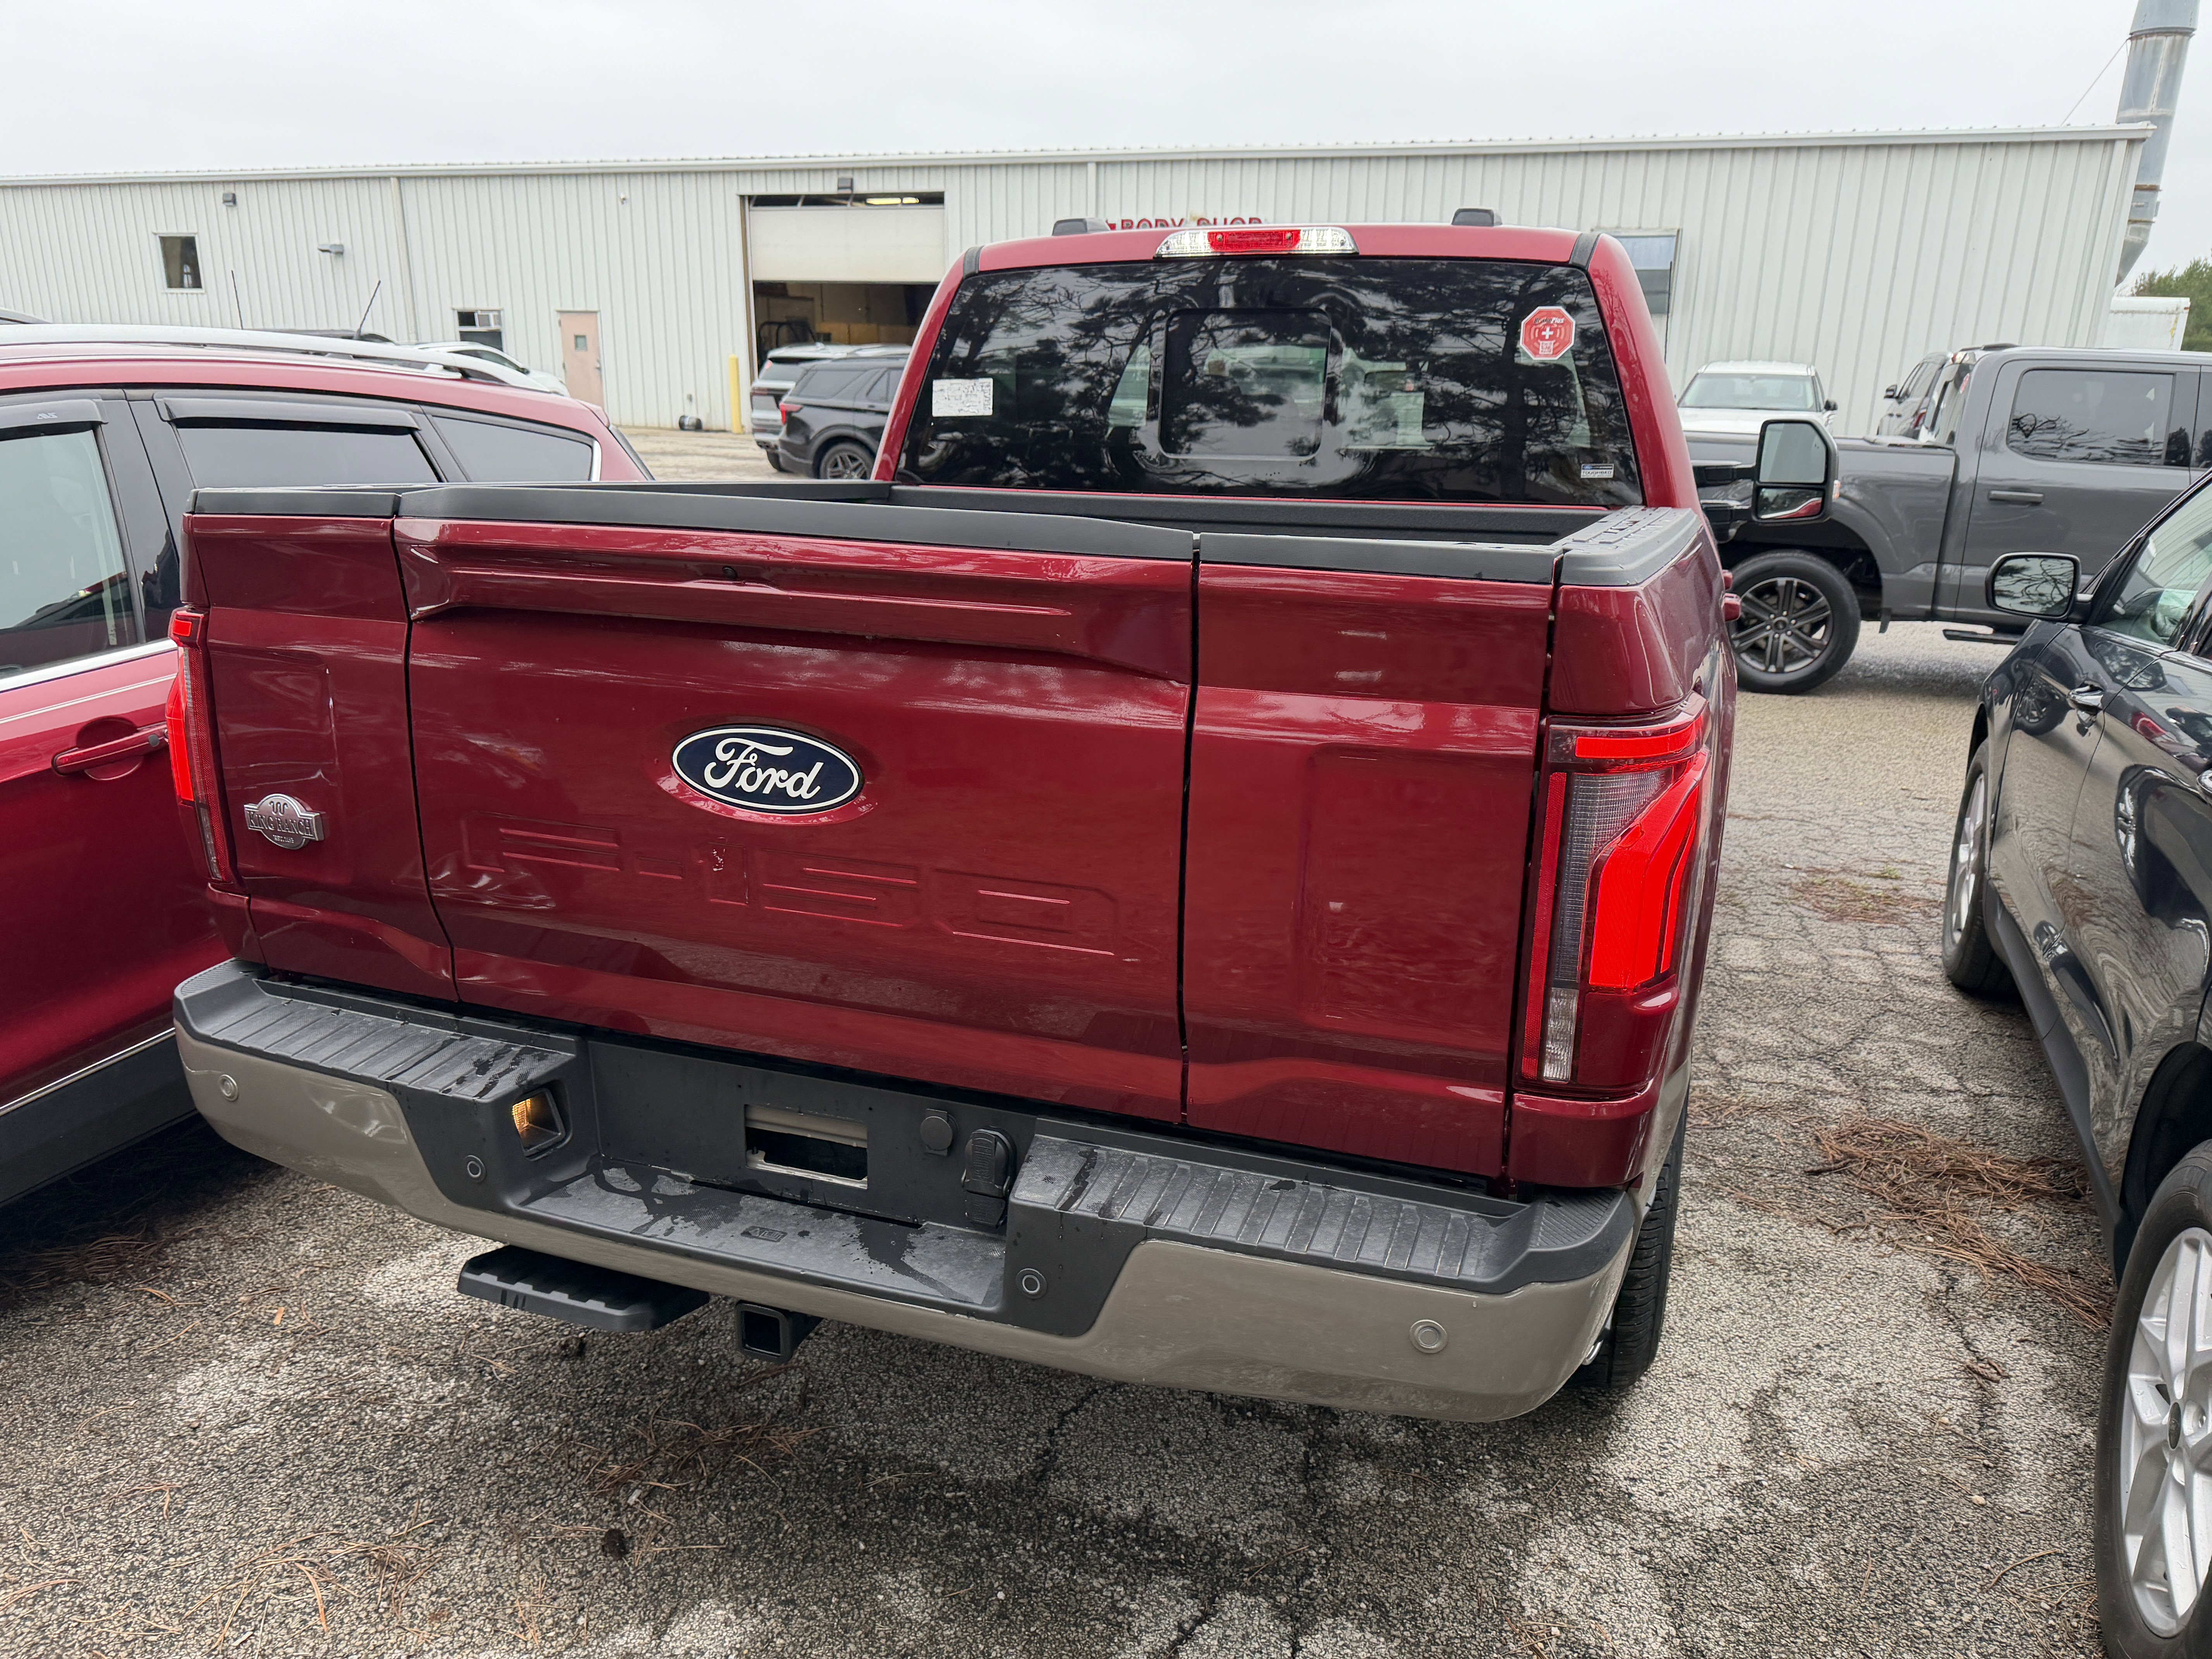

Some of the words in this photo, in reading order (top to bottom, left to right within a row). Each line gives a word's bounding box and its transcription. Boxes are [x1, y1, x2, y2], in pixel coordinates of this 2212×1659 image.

[704, 737, 824, 799] Ford
[247, 811, 275, 830] KING
[275, 817, 314, 836] RANCH
